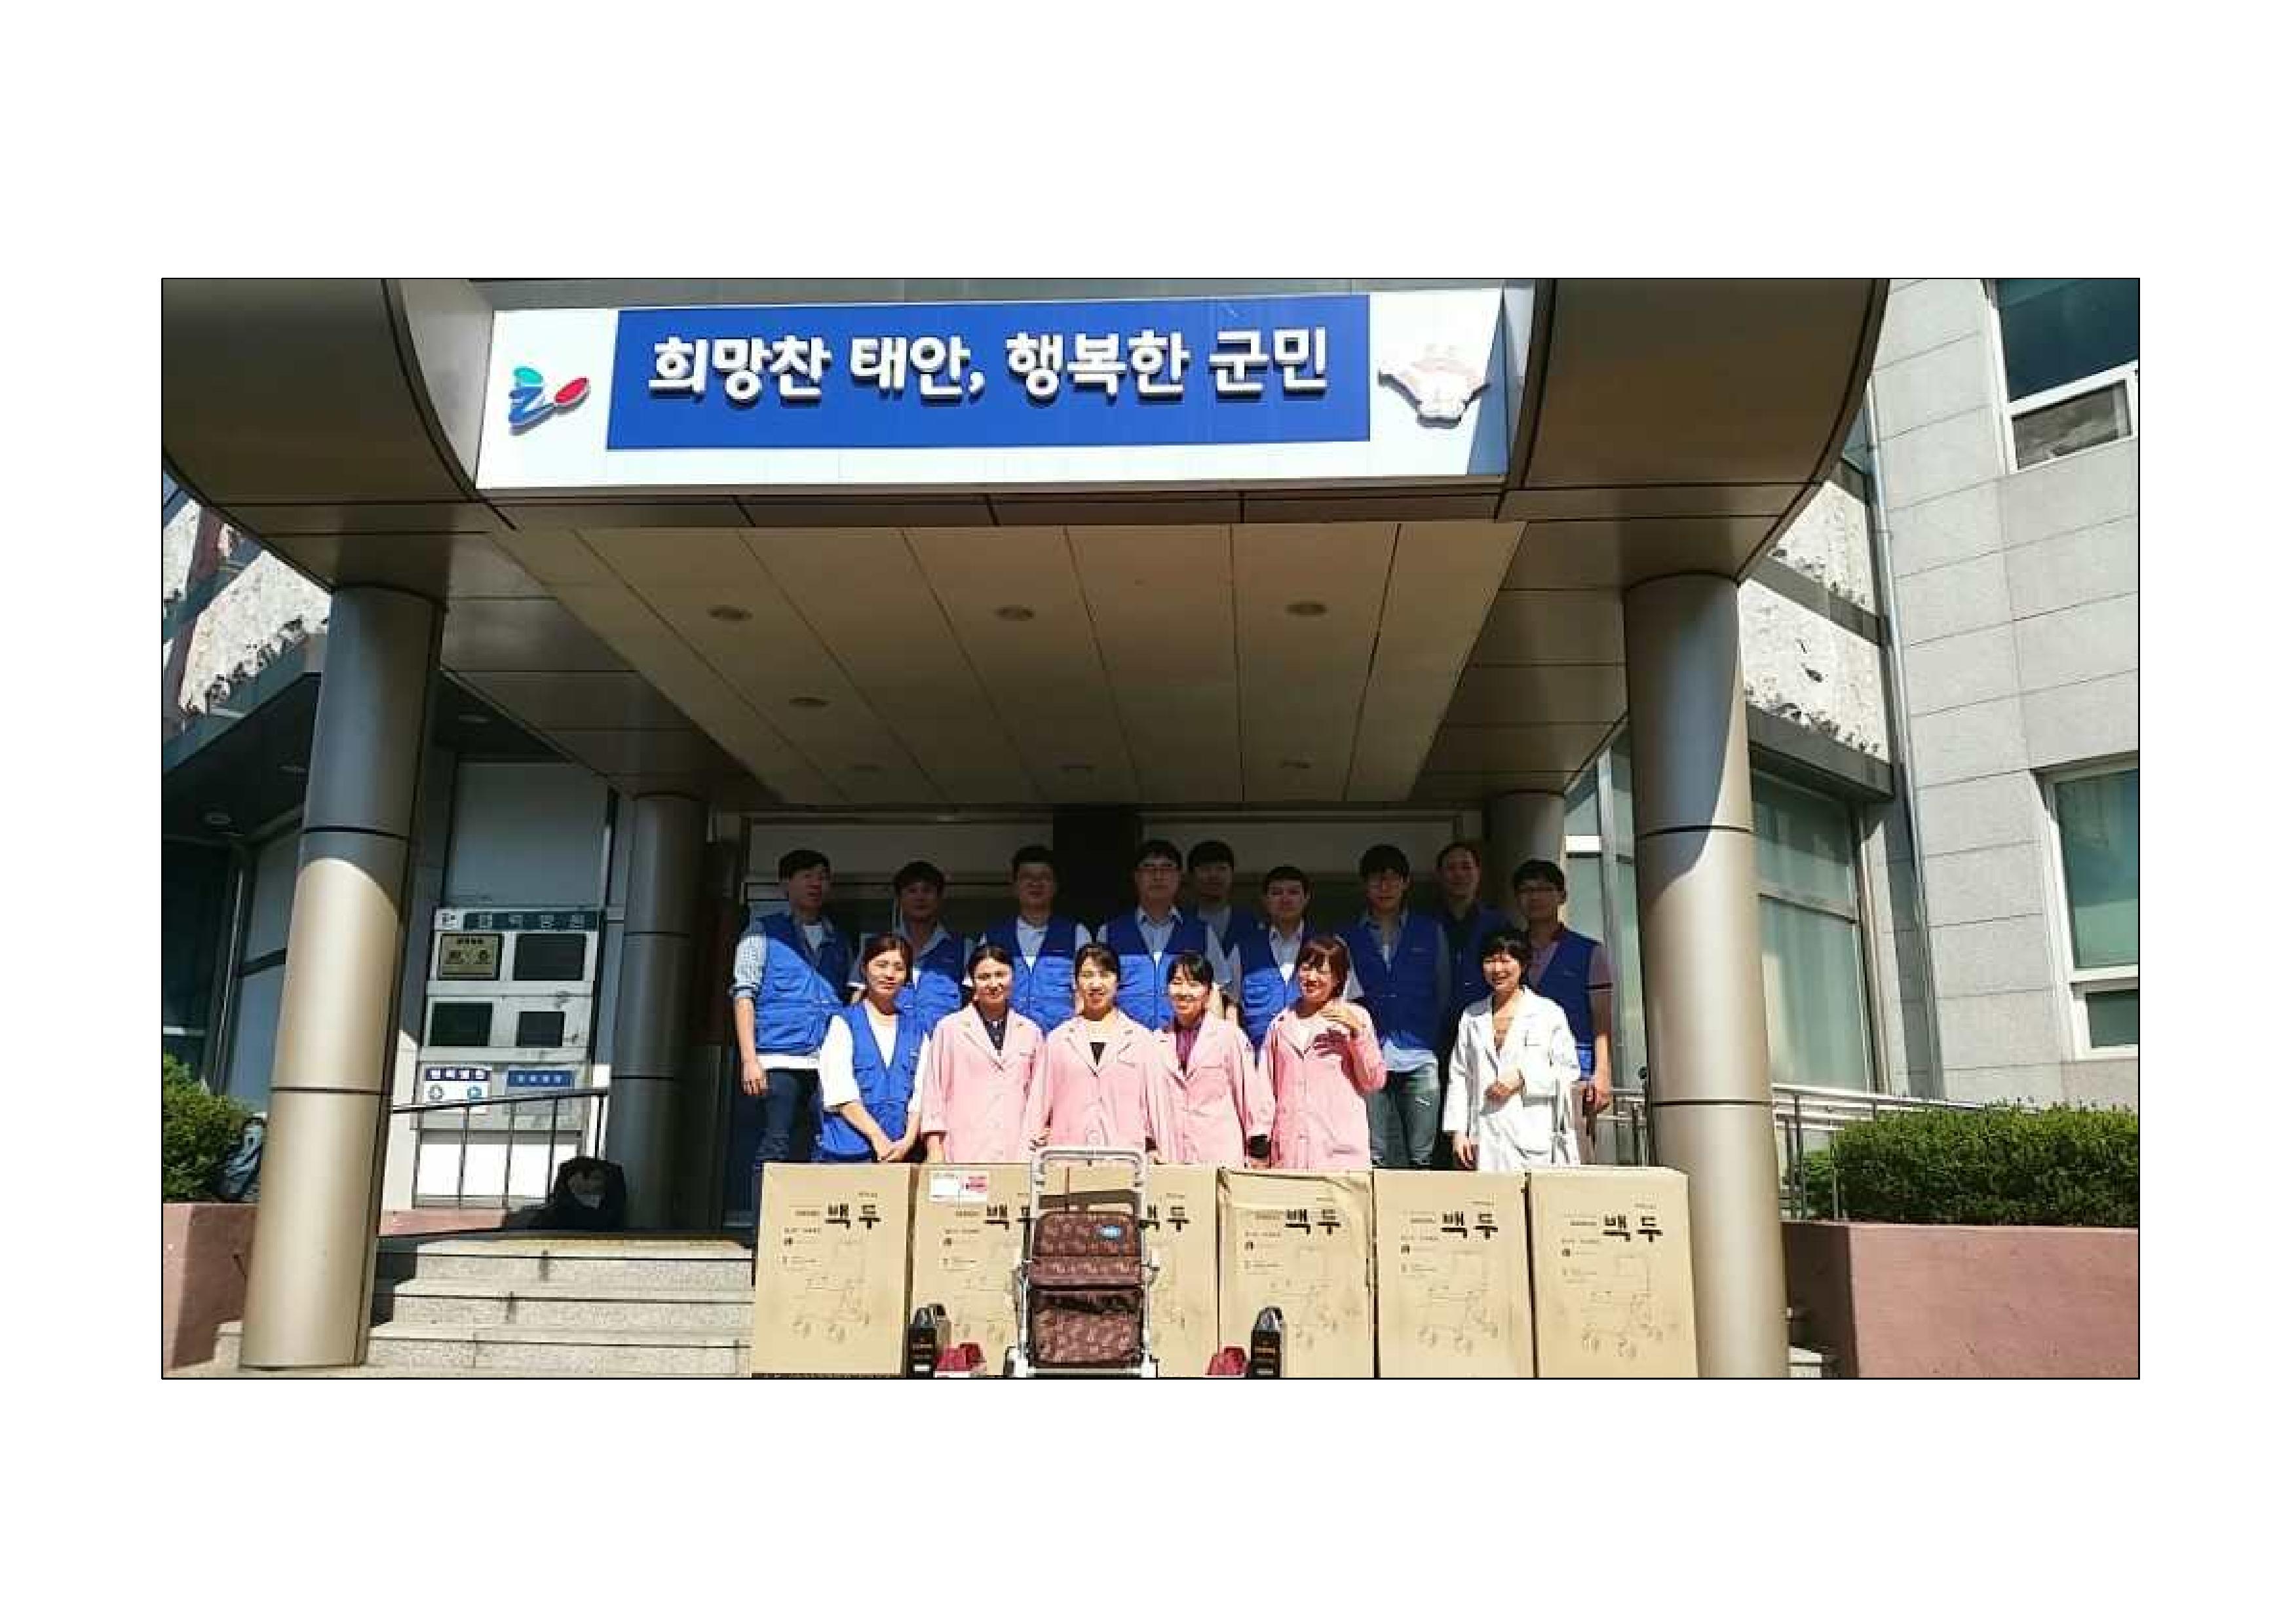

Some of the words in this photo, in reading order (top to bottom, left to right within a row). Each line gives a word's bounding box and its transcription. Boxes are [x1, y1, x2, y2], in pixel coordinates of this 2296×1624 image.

[648, 335, 832, 401] 희망찬
[851, 335, 985, 396] 태안,
[1006, 329, 1191, 398] 행복한
[1209, 327, 1328, 392] 군민
[824, 1203, 881, 1230] 백두
[1285, 1208, 1341, 1236] 백두
[1440, 1211, 1499, 1239] 백두
[1602, 1213, 1664, 1243] 백두
